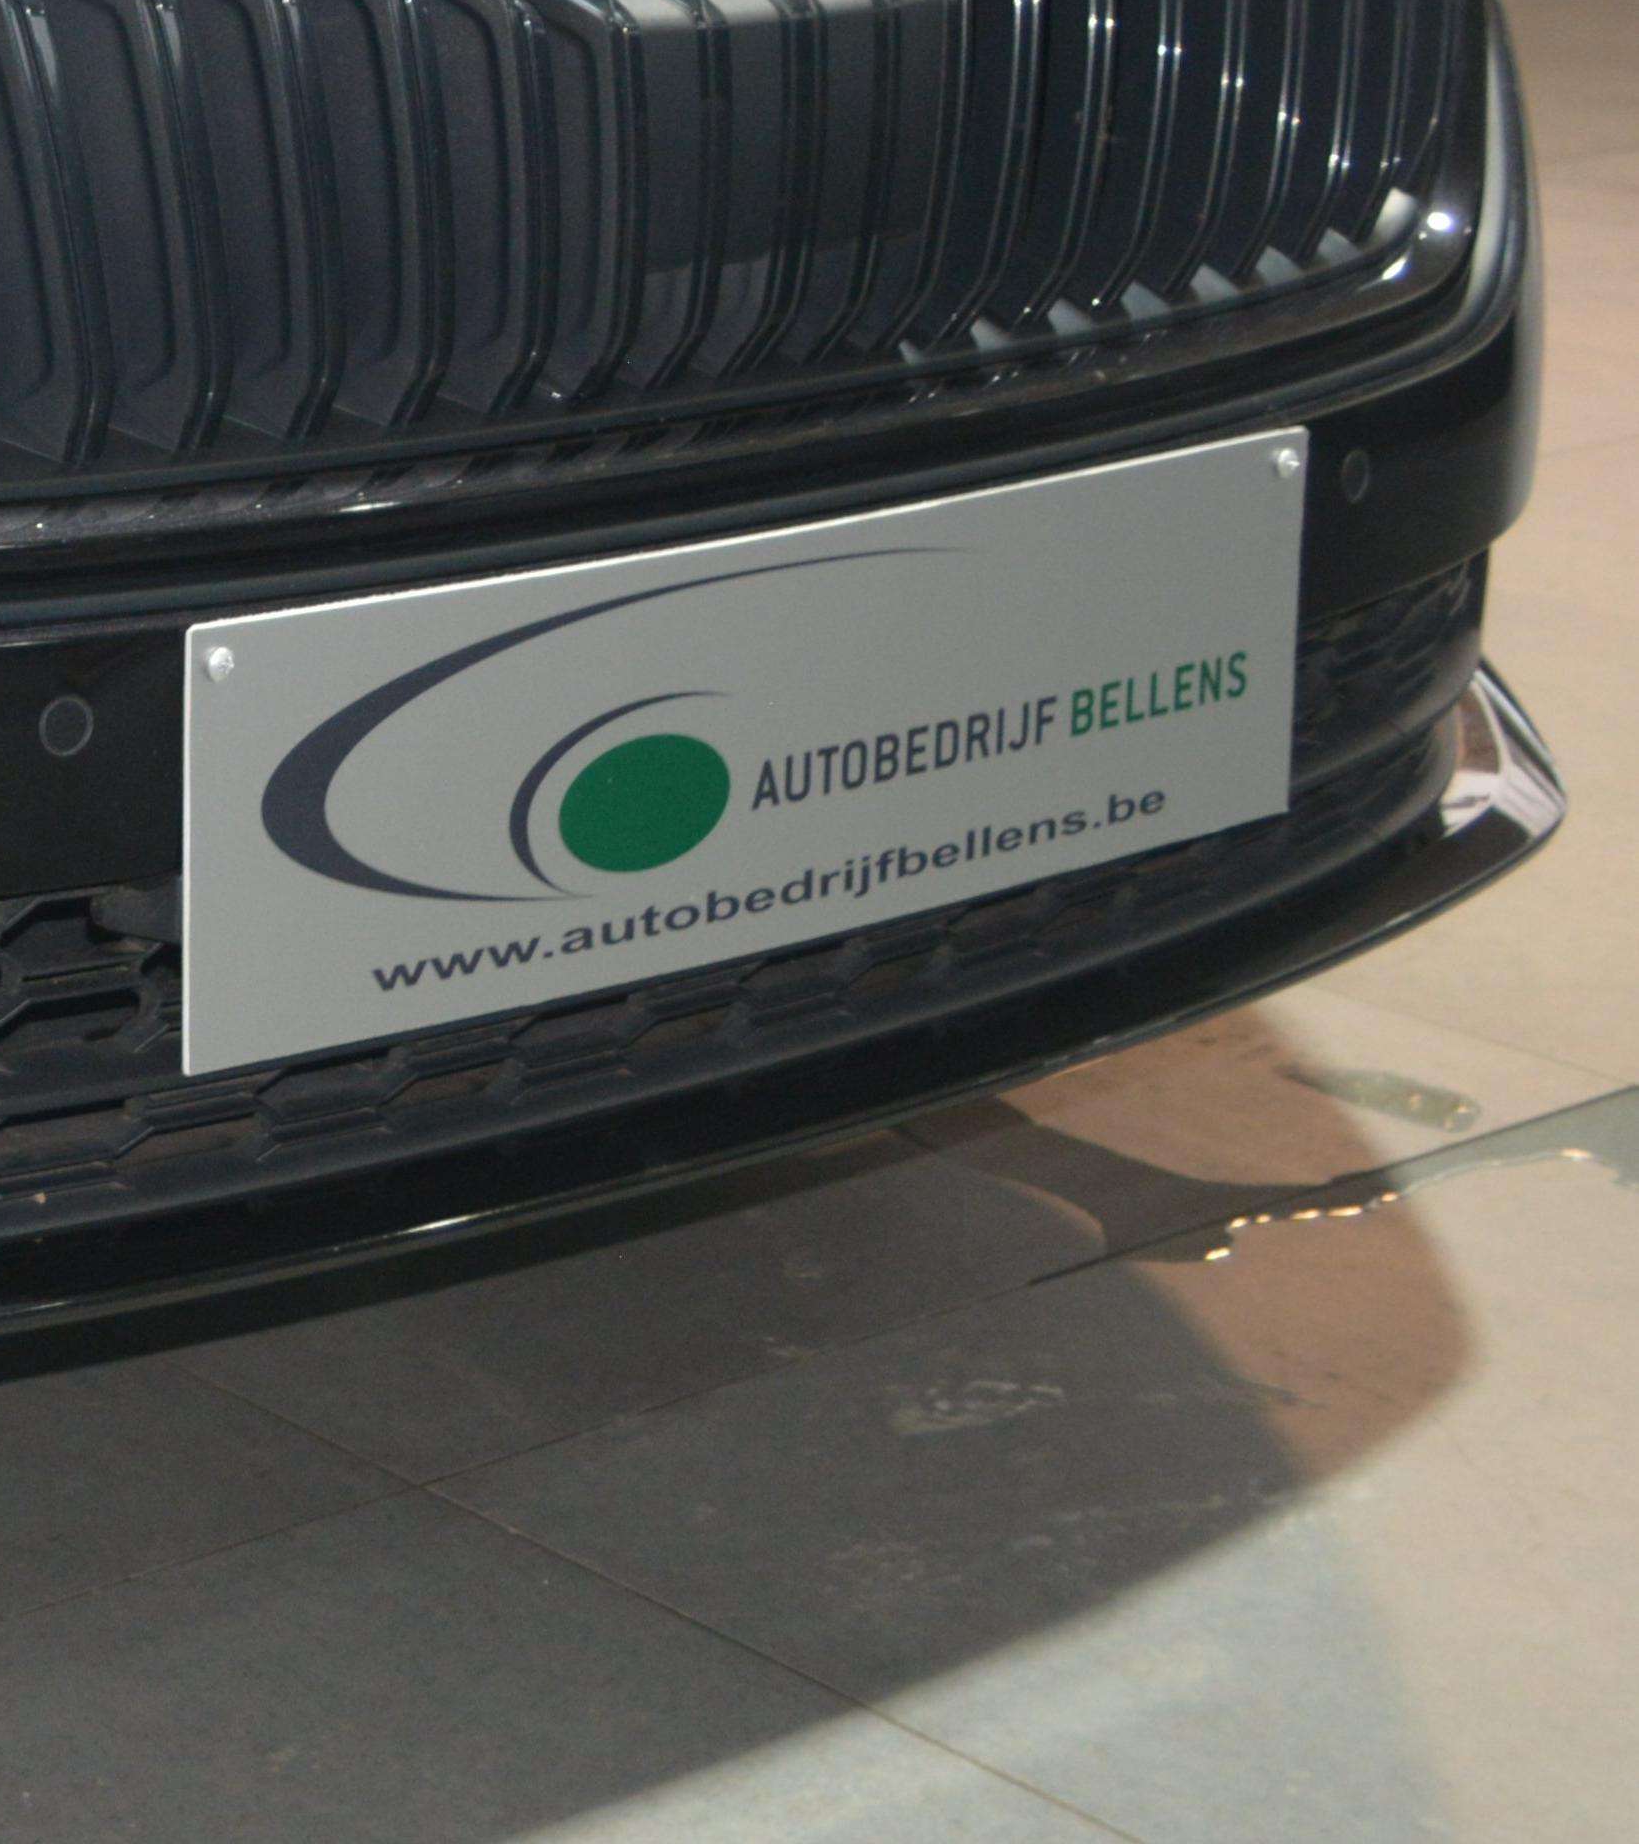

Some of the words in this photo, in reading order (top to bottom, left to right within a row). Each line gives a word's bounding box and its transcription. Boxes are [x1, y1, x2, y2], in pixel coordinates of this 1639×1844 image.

[751, 695, 1058, 812] AUTOBEDRIJF
[1070, 649, 1248, 738] BELLENS
[371, 789, 1167, 993] www.autobedrijfbellens.be
